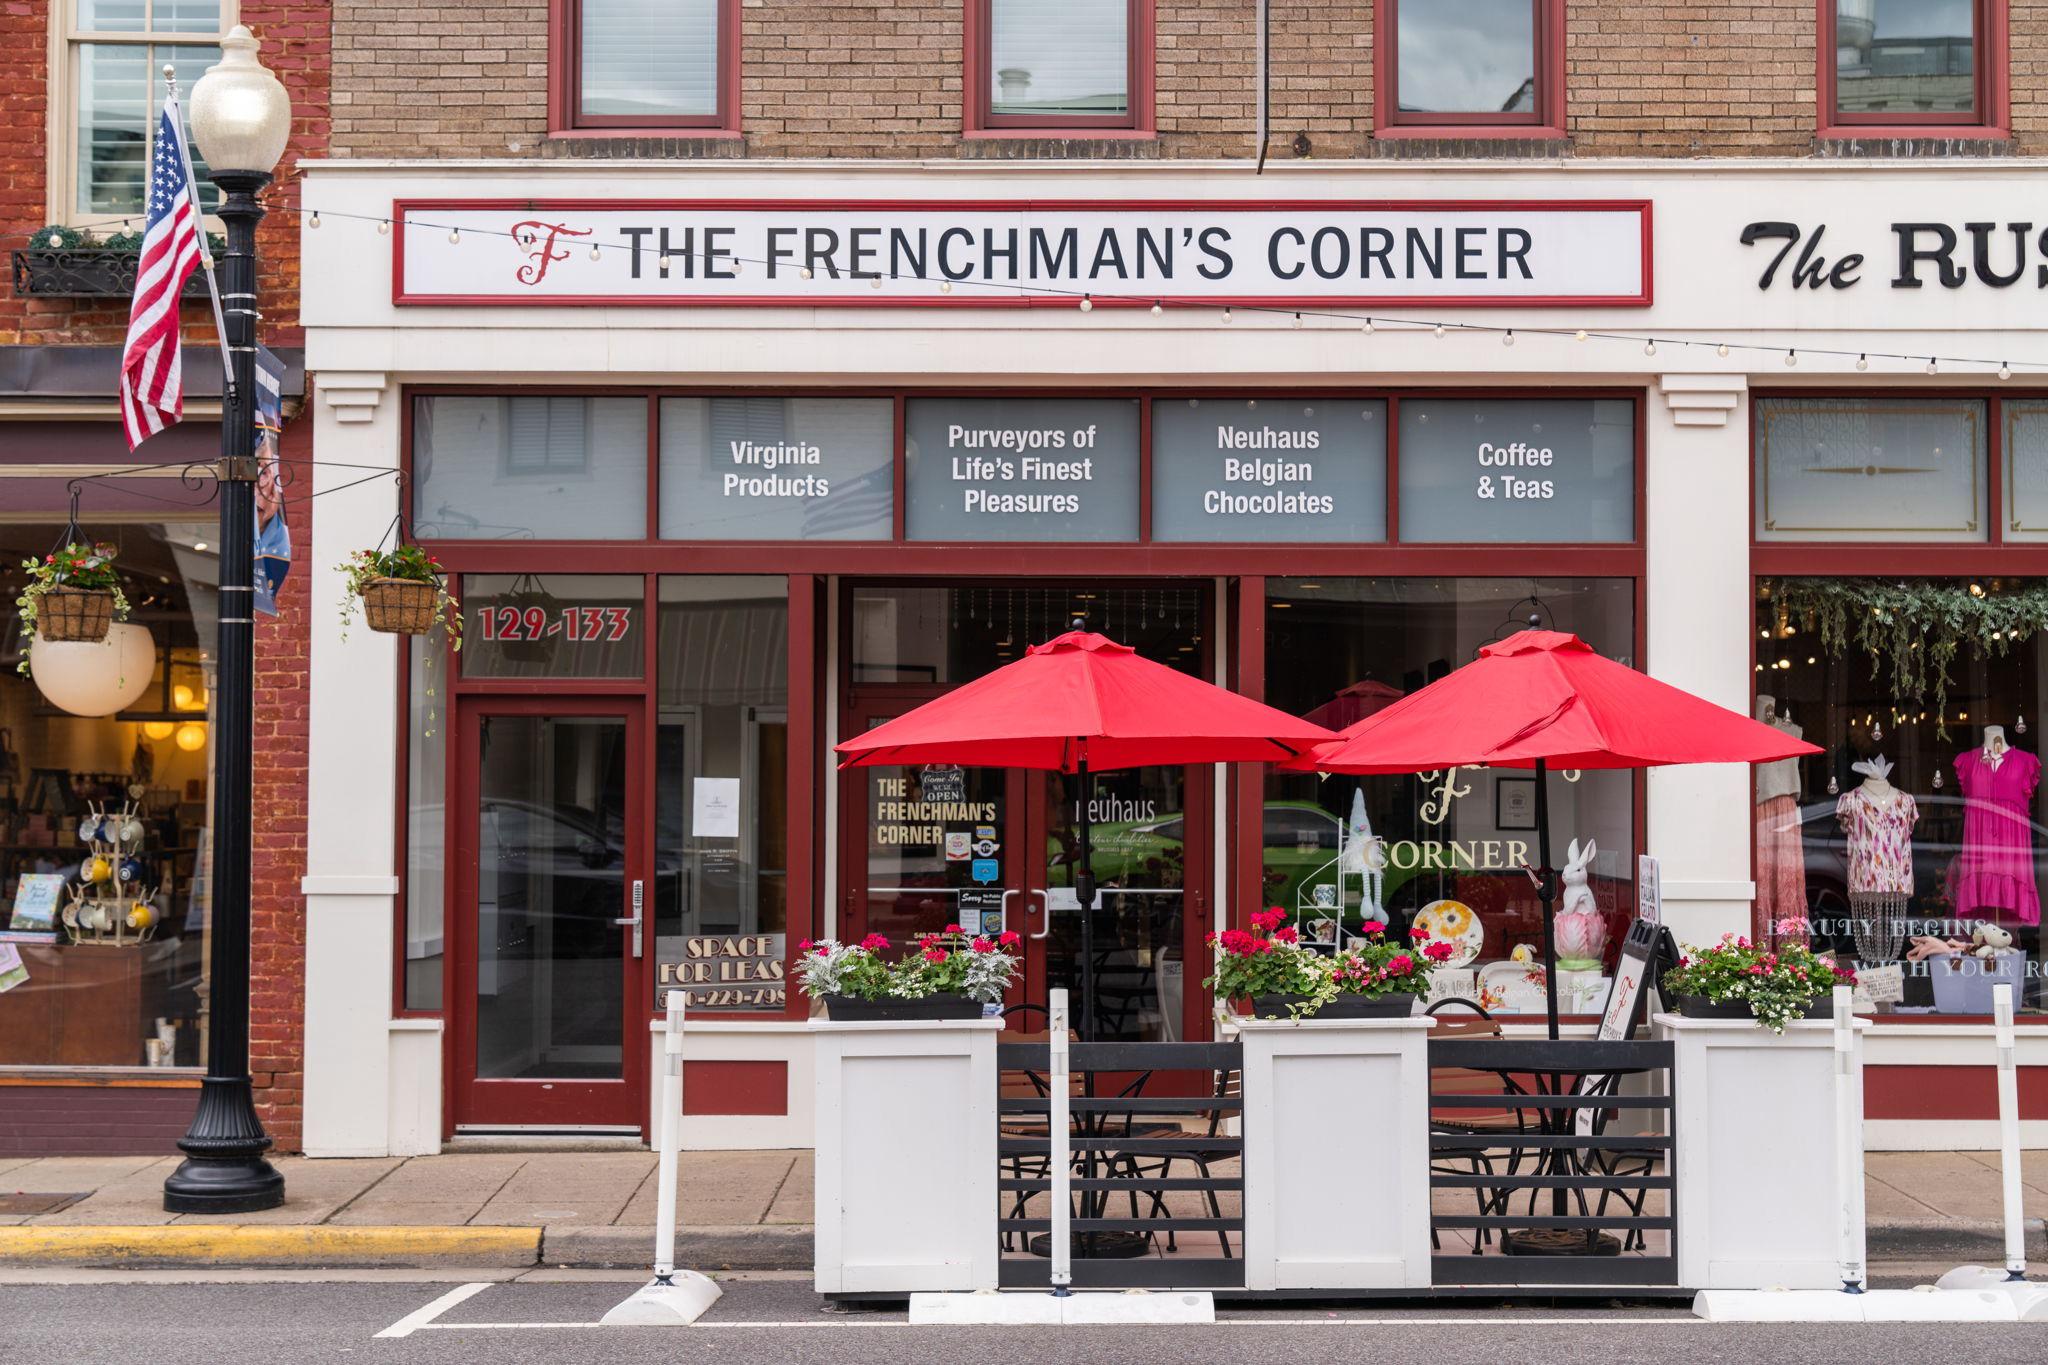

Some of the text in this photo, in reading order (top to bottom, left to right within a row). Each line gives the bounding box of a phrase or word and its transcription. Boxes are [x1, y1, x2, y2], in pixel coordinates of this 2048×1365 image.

[620, 227, 737, 279] THE
[767, 227, 1233, 280] FRENCHMAN’S
[1268, 226, 1533, 280] CORNER
[1740, 221, 2048, 291] The RU
[949, 425, 1096, 453] Purveyors of
[1218, 426, 1320, 449] Neuhaus
[731, 441, 820, 470] Virginia
[1478, 443, 1553, 466] Coffee
[952, 457, 1092, 481] Life’s Finest
[1225, 458, 1312, 486] Belgian
[724, 473, 829, 497] Products
[1477, 476, 1554, 499] & Teas
[965, 489, 1079, 513] Pleasures
[1204, 490, 1334, 514] Chocolates
[478, 606, 631, 641] 129-133
[877, 779, 907, 797] THE
[923, 774, 946, 783] Come
[927, 791, 960, 801] OPEN
[877, 802, 996, 821] FRENCHMAN'S
[877, 825, 943, 844] CORNER
[1363, 840, 1531, 869] CORNER
[1766, 918, 1988, 938] BAUTY BEGINS
[687, 936, 773, 959] SPACE
[660, 962, 713, 983] FOR
[1942, 959, 2015, 978] YOUR
